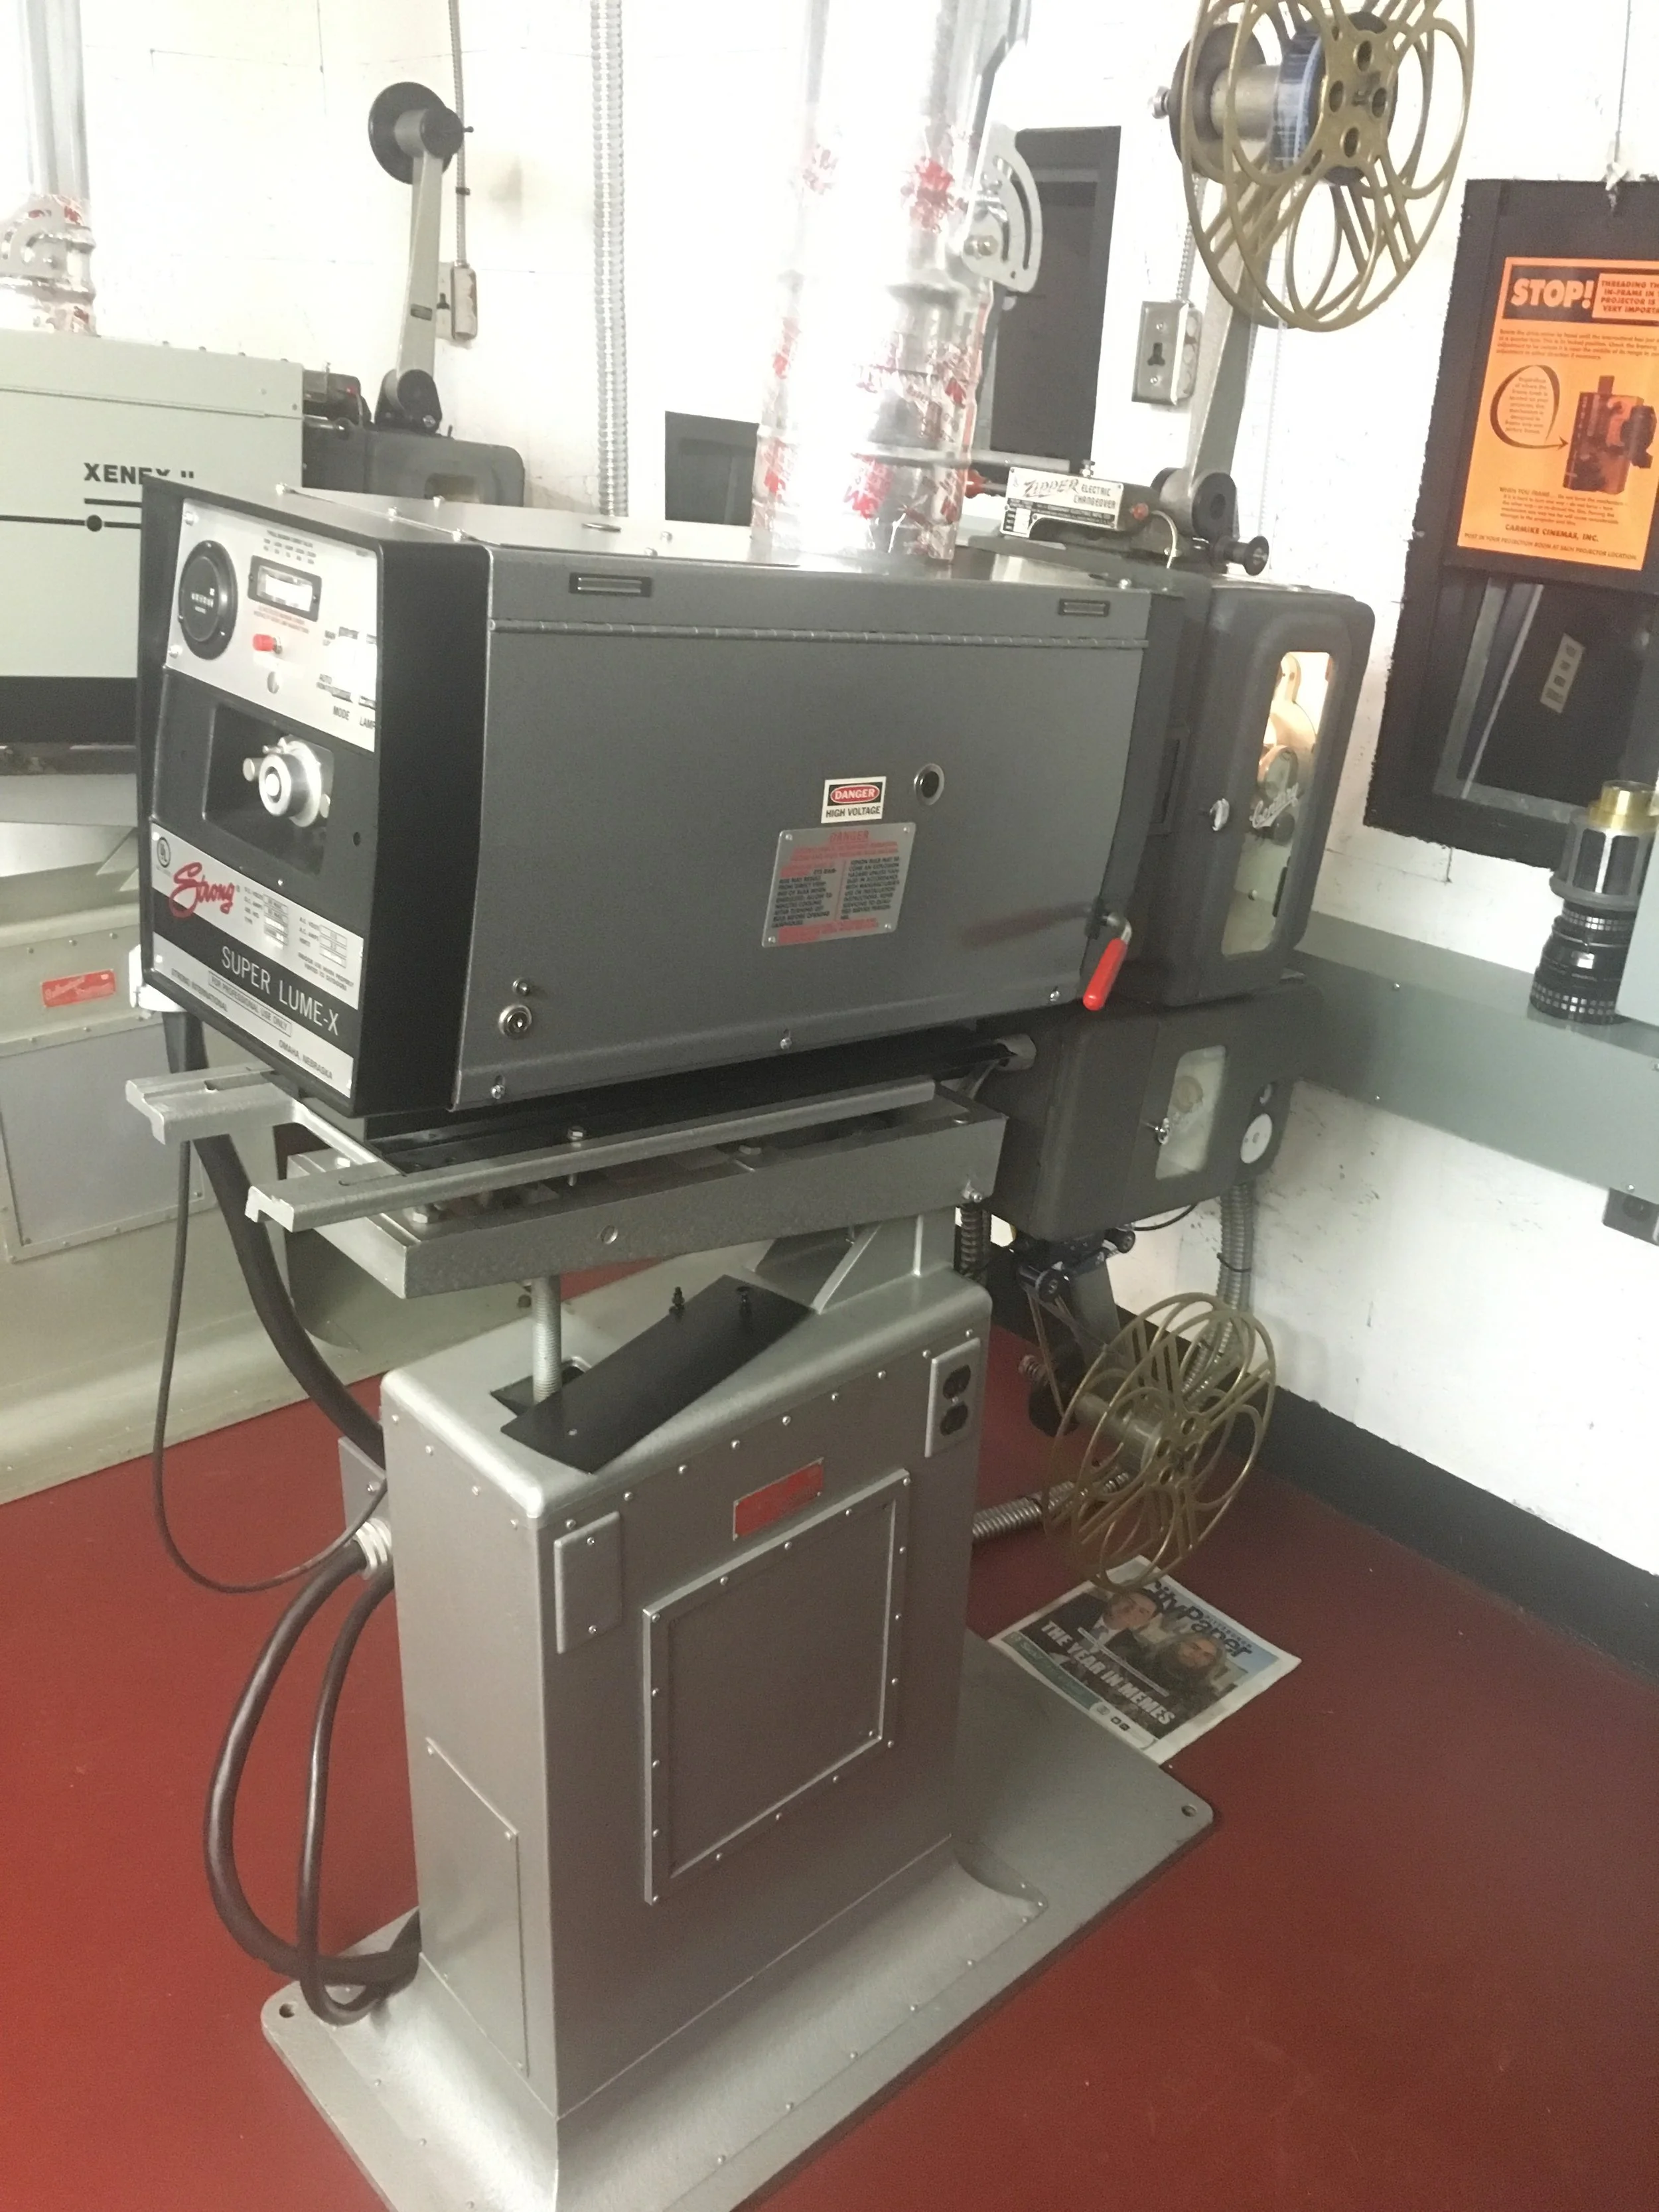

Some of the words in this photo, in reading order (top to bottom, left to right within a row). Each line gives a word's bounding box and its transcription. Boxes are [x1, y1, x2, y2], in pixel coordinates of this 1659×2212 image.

[1510, 277, 1595, 309] STOP!
[1081, 484, 1111, 496] ELECTRIC
[1073, 494, 1116, 509] CHANGEOVER
[1505, 524, 1540, 535] CARMIKE
[1582, 533, 1599, 542] INC.
[333, 706, 350, 721] MODE
[834, 788, 876, 800] DANGER
[826, 808, 845, 818] HIGH
[847, 806, 881, 816] VOLTAGE
[169, 861, 235, 919] Strong
[221, 945, 271, 995] SUPER
[279, 979, 339, 1037] LUME-X
[261, 1007, 271, 1021] USE
[273, 1015, 288, 1031] ONLY
[303, 1055, 332, 1080] NEBRASKA
[1041, 1621, 1073, 1647] THE
[1067, 1642, 1106, 1674] YEAR
[1100, 1670, 1123, 1687] IN
[1118, 1682, 1176, 1725] MEMES
